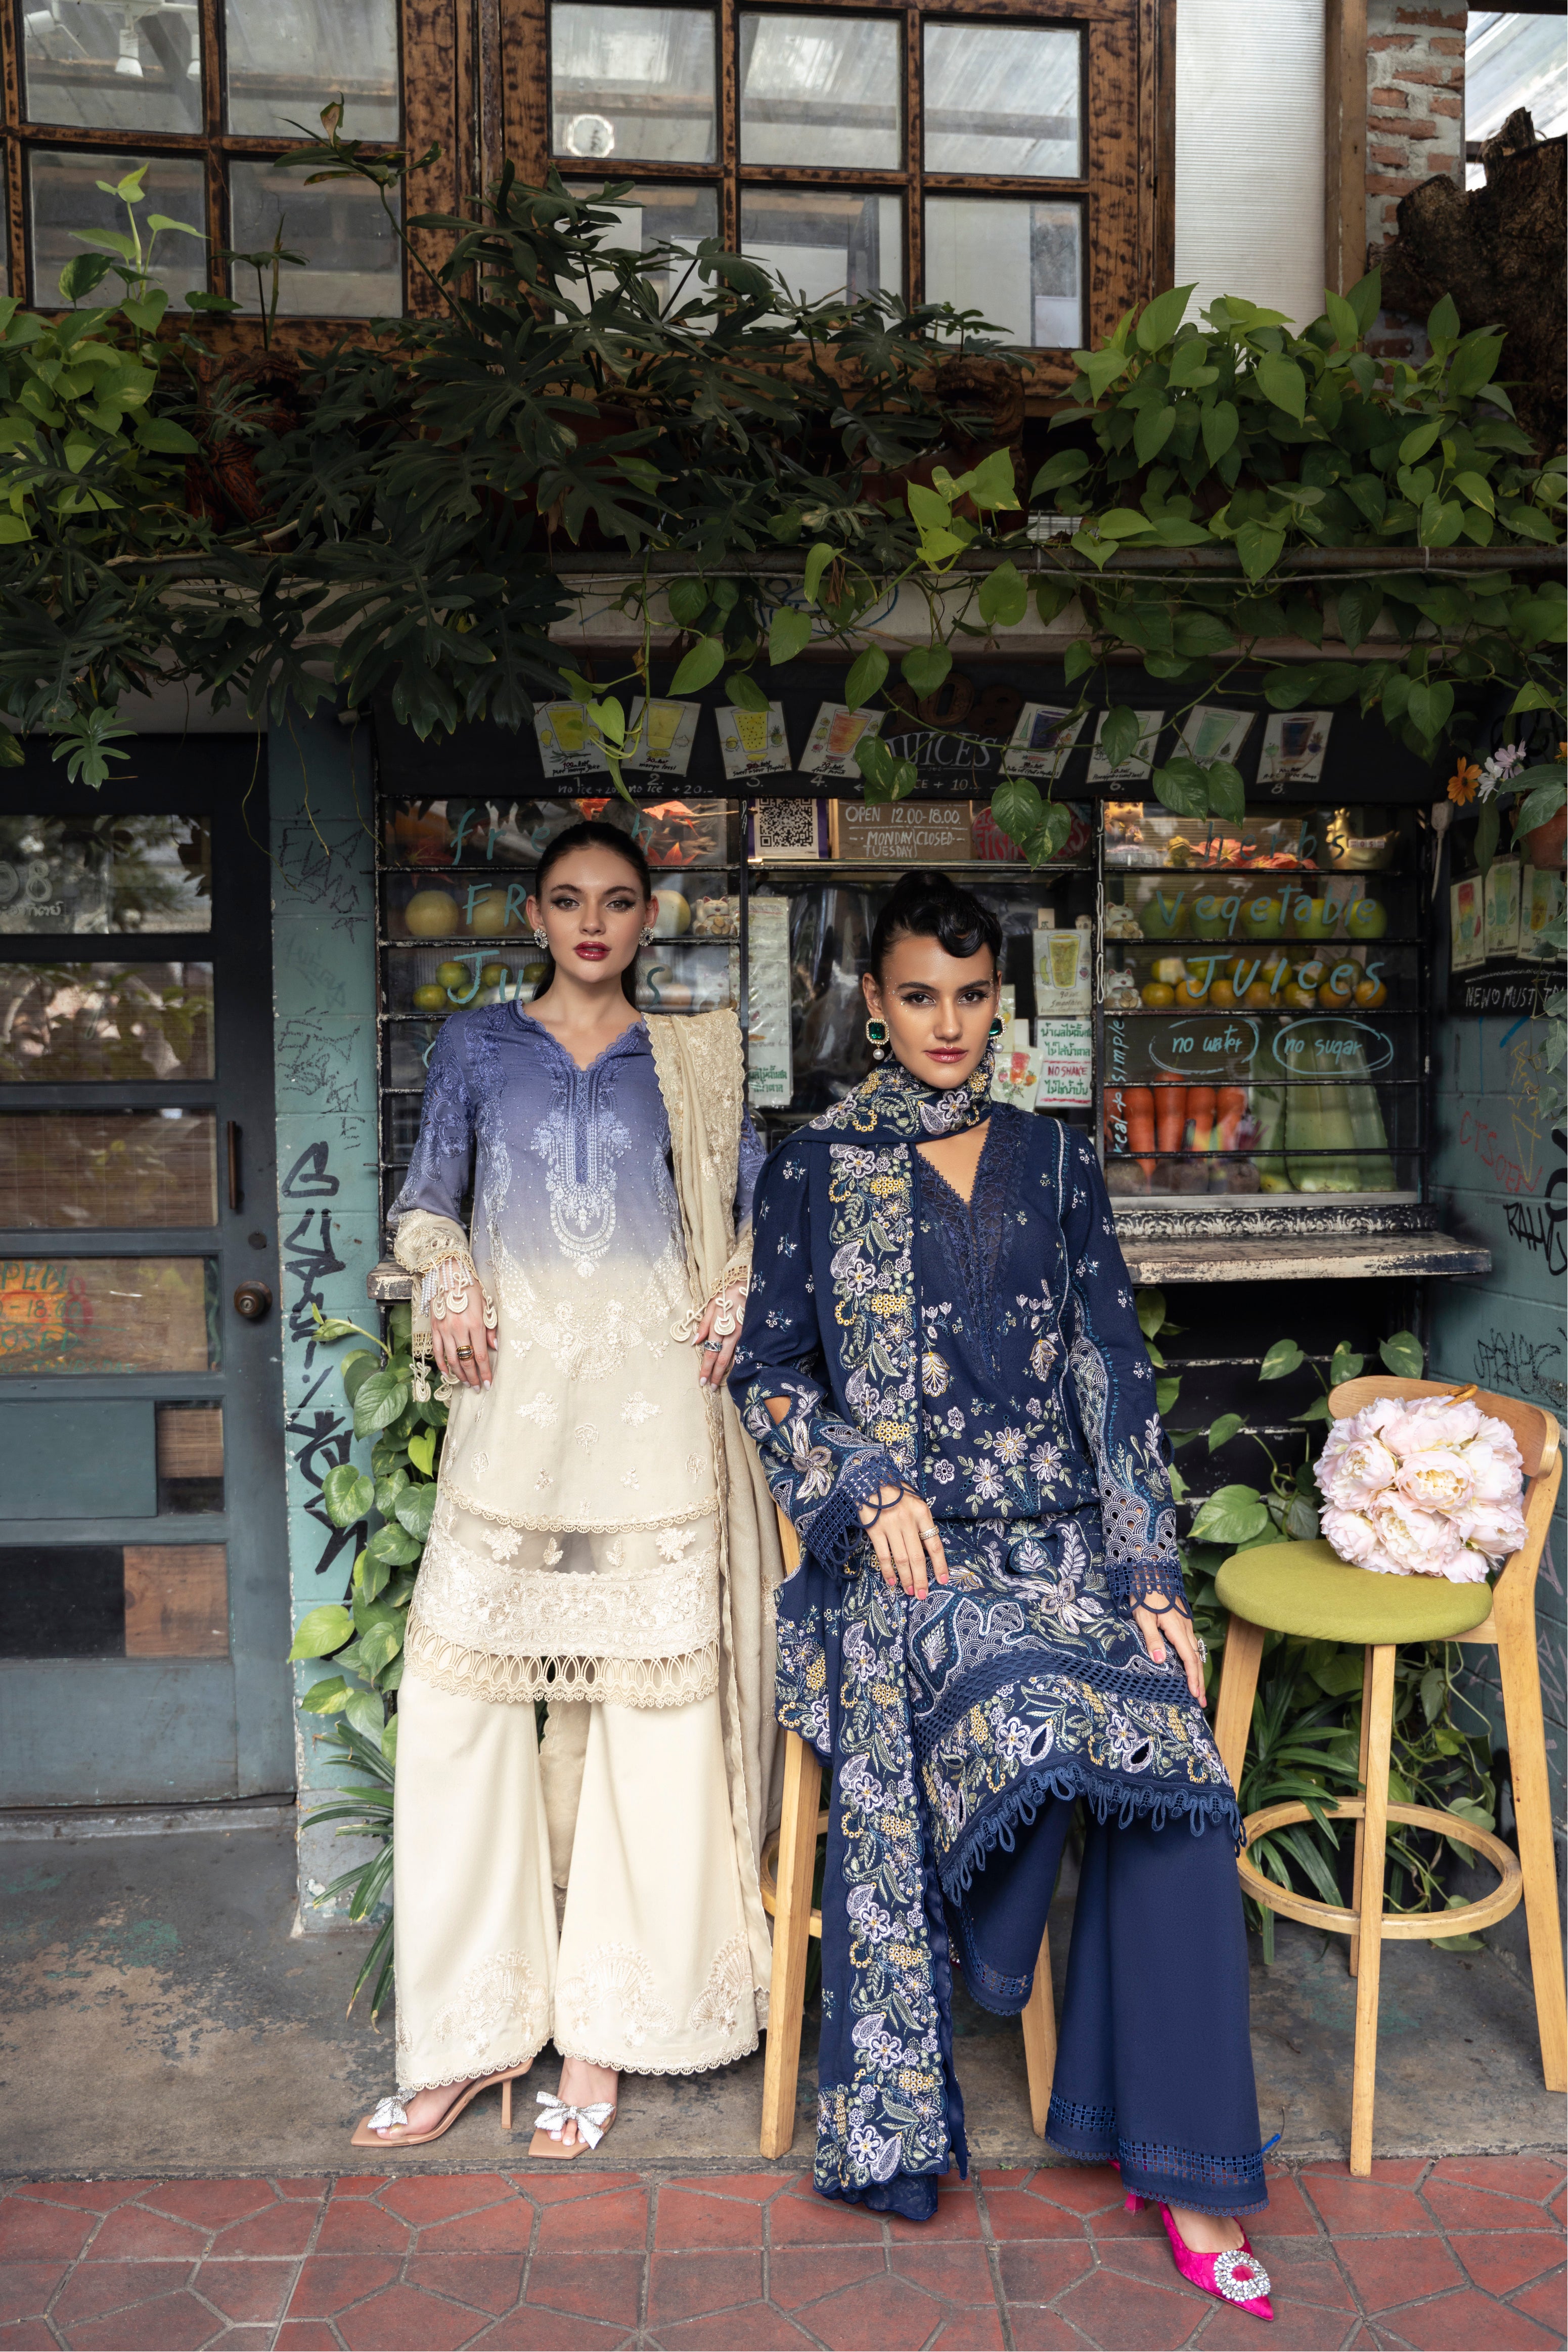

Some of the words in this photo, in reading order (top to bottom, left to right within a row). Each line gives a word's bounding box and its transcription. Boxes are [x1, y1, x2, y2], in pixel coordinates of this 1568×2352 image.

[639, 763, 660, 771] mango
[647, 773, 664, 786] 2.
[810, 774, 828, 787] 4.
[558, 785, 573, 793] no
[628, 785, 643, 793] no
[846, 806, 881, 823] OPEN
[867, 831, 912, 846] MONDAY
[916, 831, 953, 846] CLOSED
[1204, 820, 1346, 863] herbs
[863, 845, 913, 858] TUESDAY
[1156, 883, 1377, 936] Vegetable
[1465, 986, 1491, 1009] NEW
[1502, 986, 1536, 1008] MUST
[1172, 1035, 1193, 1053] no
[1202, 1024, 1243, 1054] water
[1107, 1018, 1129, 1083] simple
[1283, 1036, 1305, 1054] no
[1314, 1035, 1363, 1064] sugar
[1048, 1066, 1060, 1076] NO
[1061, 1066, 1088, 1078] SHAKE
[1110, 1114, 1128, 1153] real
